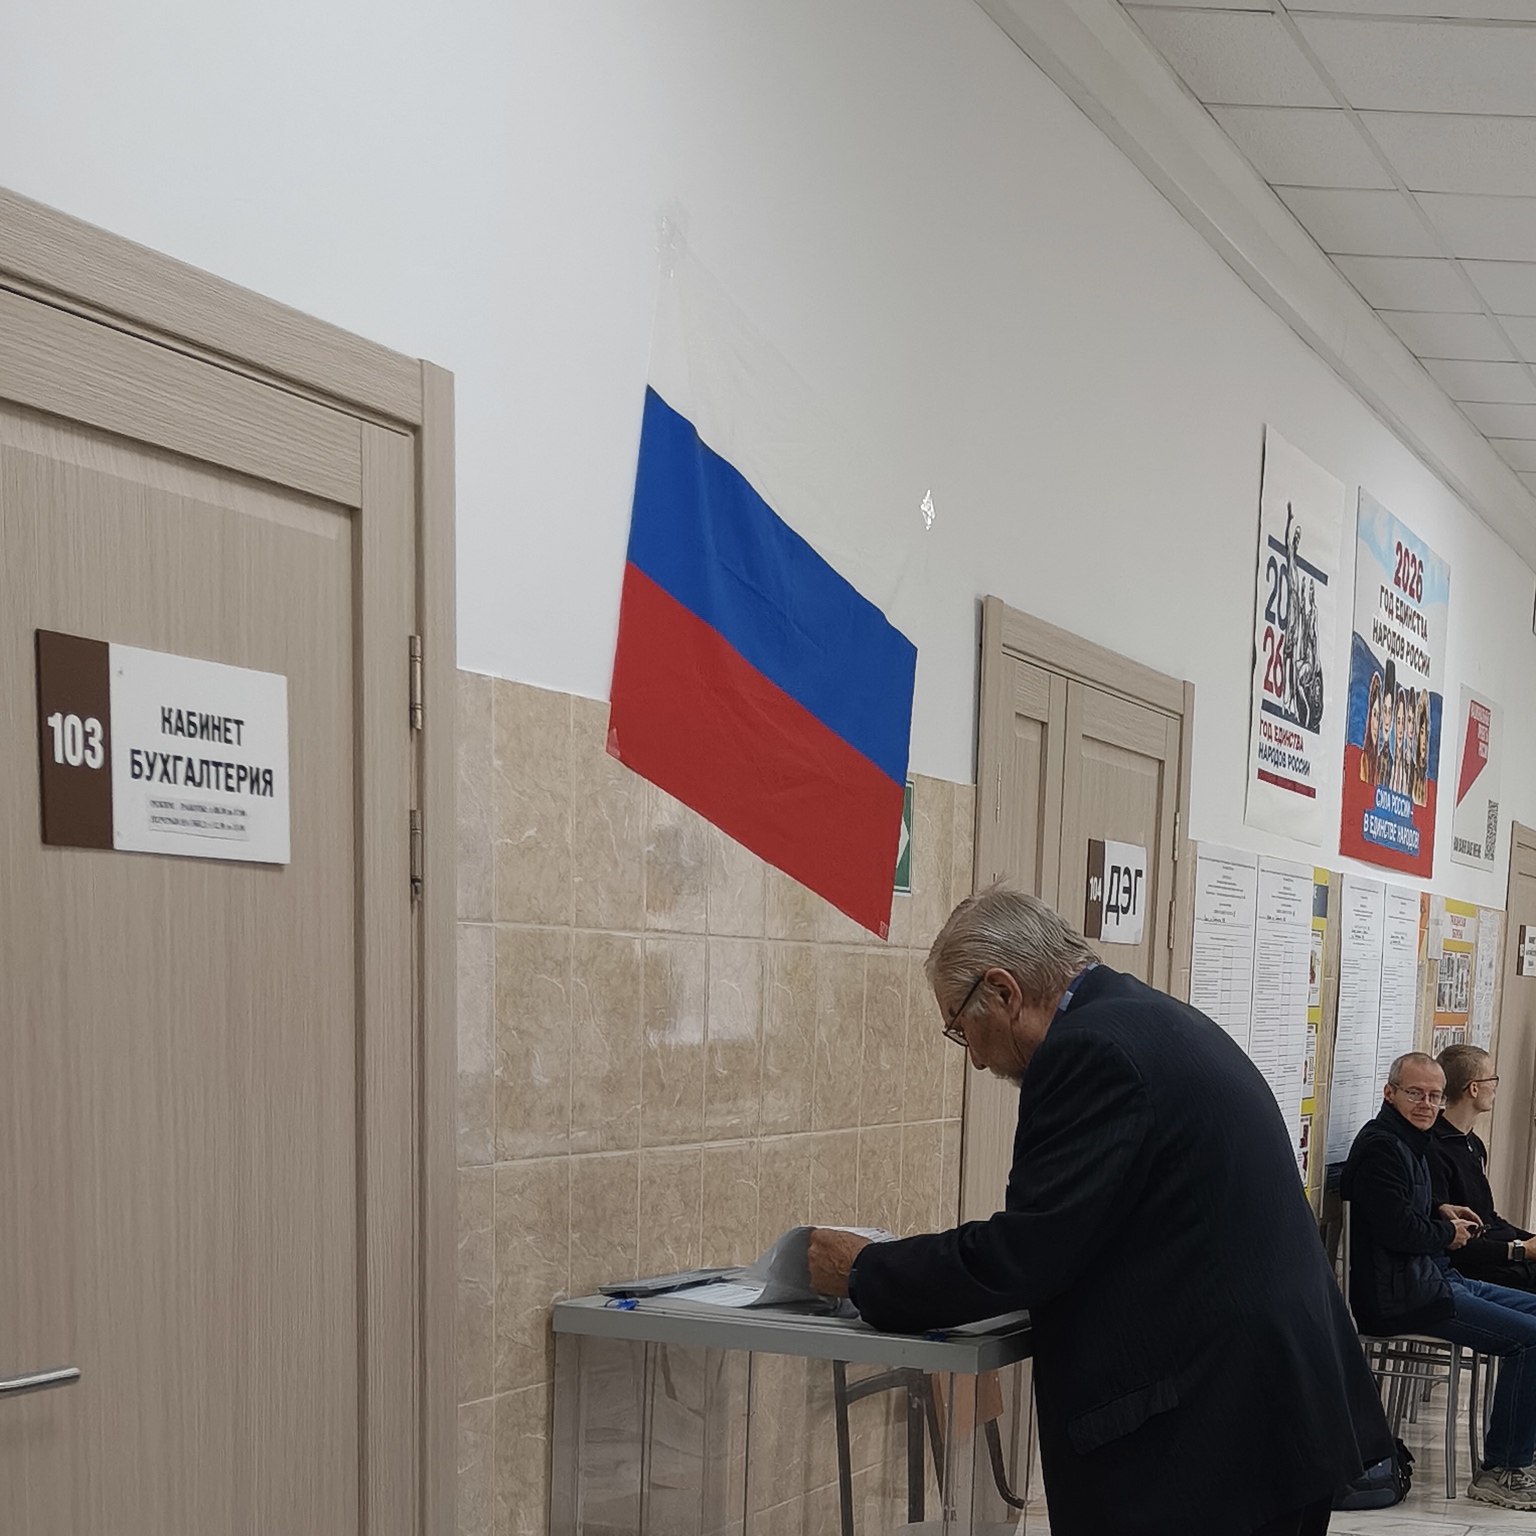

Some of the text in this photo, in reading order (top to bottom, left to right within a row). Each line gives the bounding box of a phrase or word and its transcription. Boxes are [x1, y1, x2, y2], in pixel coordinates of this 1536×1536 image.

[1264, 555, 1289, 631] 20
[1394, 541, 1424, 604] 2026
[1379, 584, 1428, 642] ГОД ЕДИНСТВА
[1262, 625, 1286, 698] 26
[1372, 617, 1431, 678] НАРОДОВ РОССИИ
[47, 711, 105, 770] 103
[160, 705, 245, 747] КАБИНЕТ
[1259, 718, 1305, 752] ГОД ЕДИНСТВА
[129, 748, 274, 798] БУХГАЛТЕРИЯ
[1258, 741, 1311, 777] НАРОДОВ РОССИИ
[1363, 812, 1370, 833] В
[1369, 815, 1397, 841] ЕДИНСТВЕ
[1375, 788, 1391, 812] СИЛА
[1391, 794, 1411, 818] РОССИИ
[1105, 864, 1143, 926] ДЭГ
